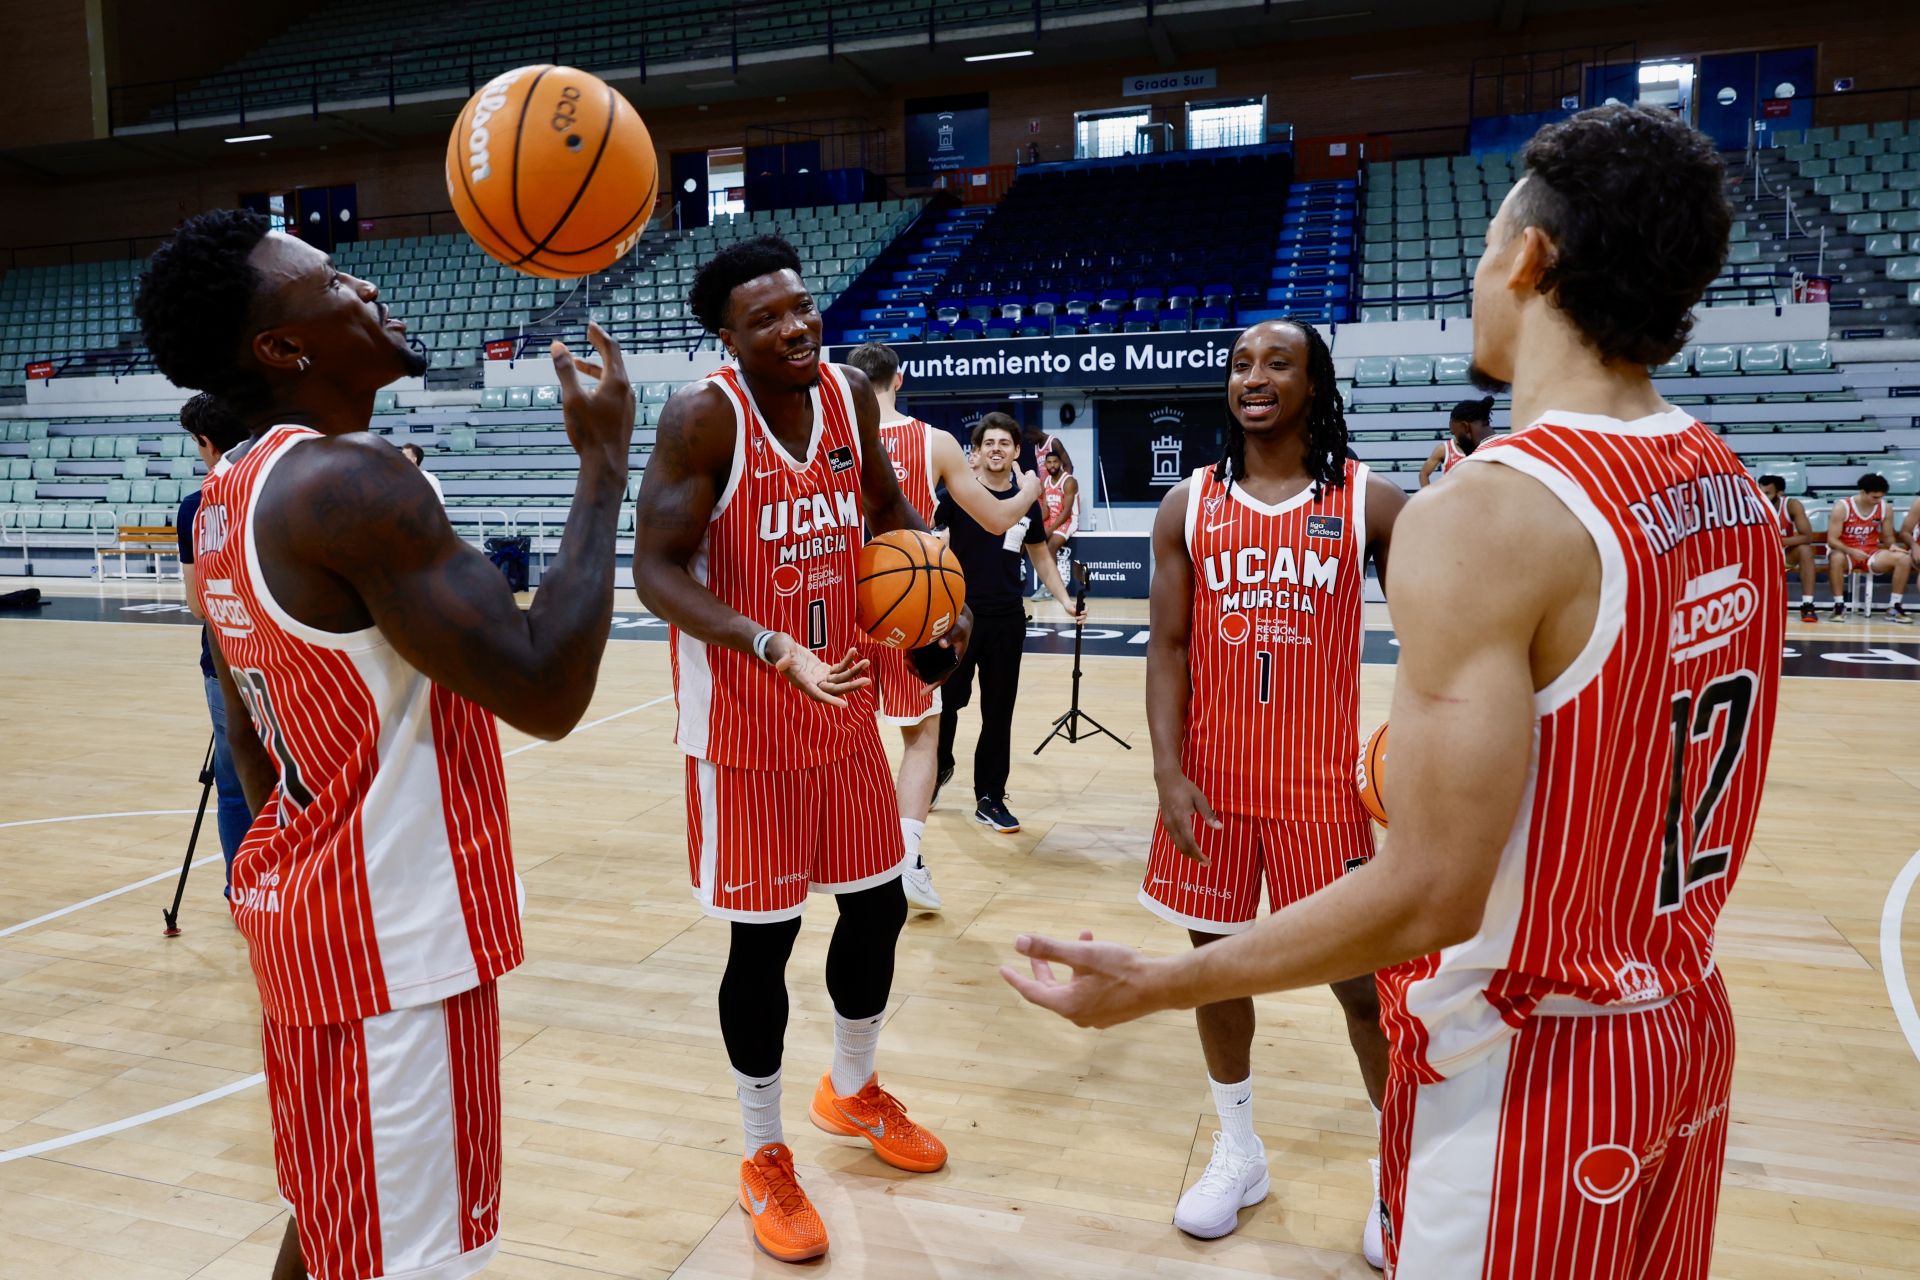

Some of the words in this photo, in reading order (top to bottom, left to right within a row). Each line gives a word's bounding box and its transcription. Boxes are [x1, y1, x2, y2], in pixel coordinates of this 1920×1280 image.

[1134, 78, 1178, 91] Grada
[1183, 75, 1205, 86] Sur
[552, 86, 581, 132] acb
[897, 349, 1071, 378] yuntamiento
[1079, 346, 1115, 372] de
[1125, 341, 1230, 370] Murcia
[759, 490, 860, 541] UCAM
[1310, 521, 1324, 530] liga
[1309, 528, 1340, 537] endesa
[779, 534, 847, 565] MURCIA
[1089, 571, 1126, 581] Murcia
[1203, 546, 1341, 597] UCAM
[1221, 589, 1316, 615] MURCIA
[808, 598, 828, 650] 0
[1256, 624, 1297, 635] REGIÓN
[1256, 633, 1270, 643] DE
[1272, 635, 1313, 646] MURCIA
[1256, 650, 1272, 705] 1
[1652, 668, 1759, 916] 12
[1180, 880, 1232, 900] INVERSUS
